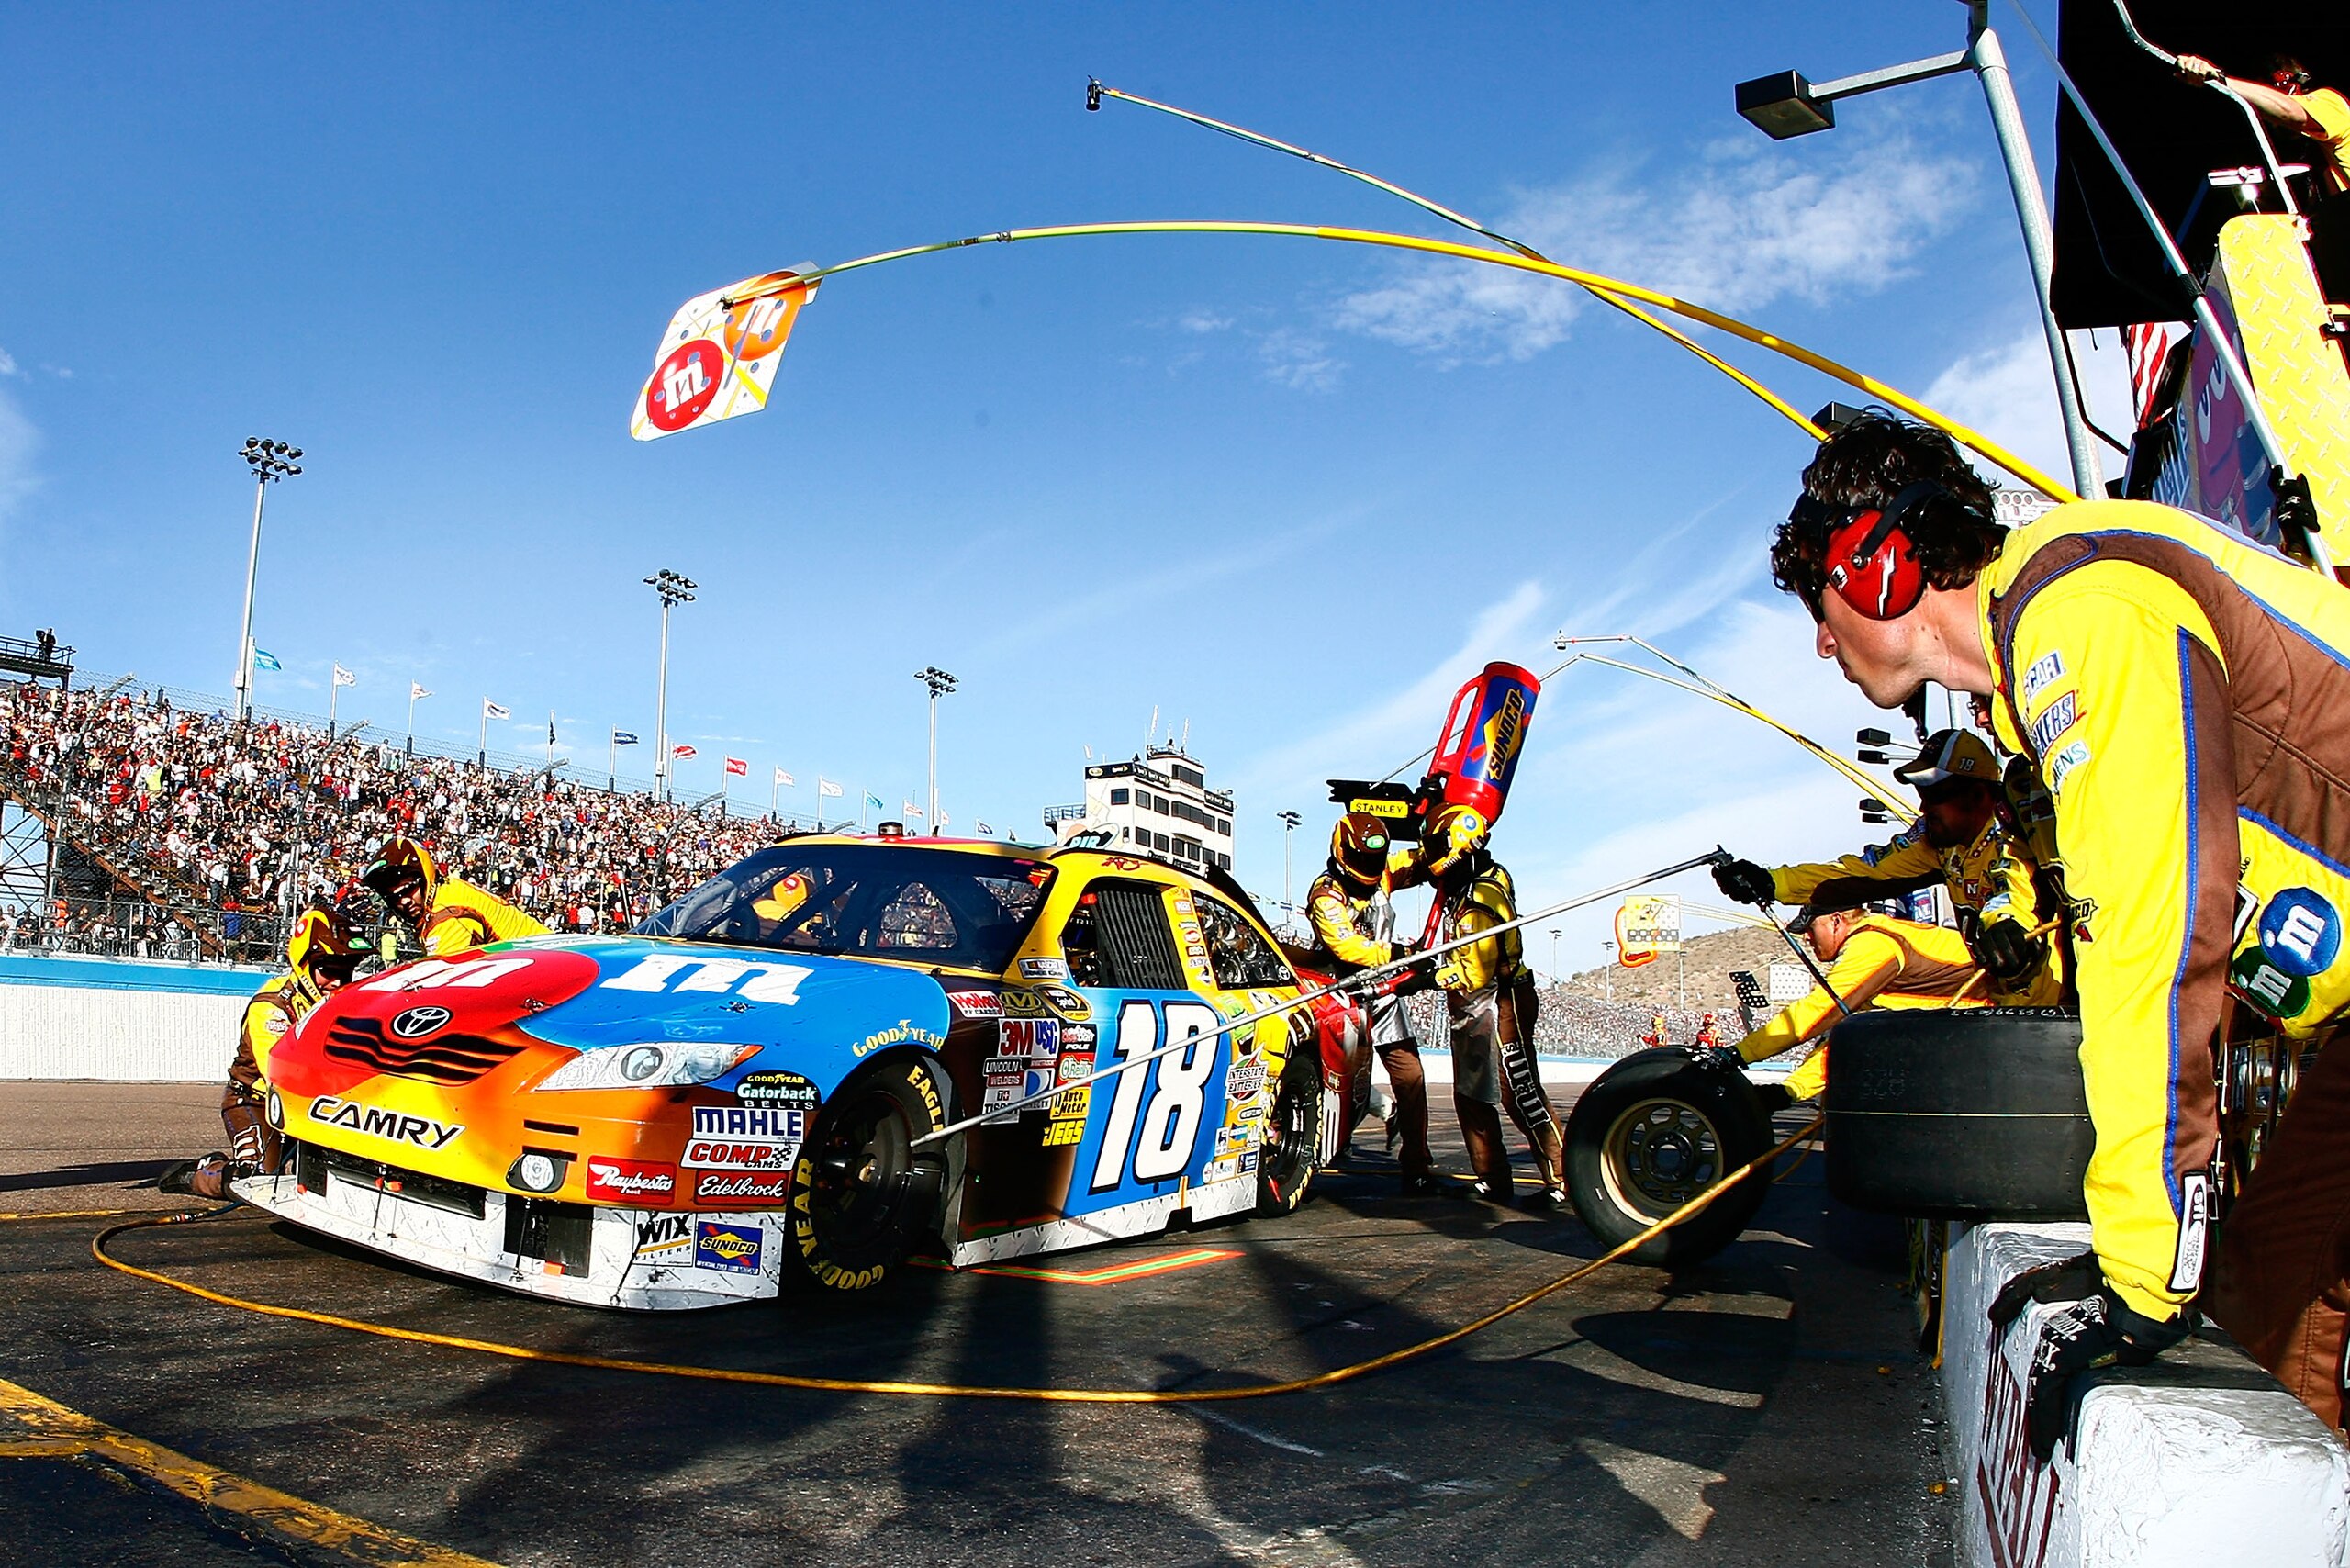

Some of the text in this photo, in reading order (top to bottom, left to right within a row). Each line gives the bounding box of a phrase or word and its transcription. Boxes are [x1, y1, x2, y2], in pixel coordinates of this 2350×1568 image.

[1488, 689, 1525, 779] SUNOCO
[1958, 758, 1975, 772] 18
[1355, 802, 1404, 814] STANLEY
[1069, 835, 1101, 848] PIR
[2277, 904, 2326, 962] m
[599, 953, 815, 1006] m
[2249, 964, 2293, 1007] m
[951, 993, 1003, 1014] Holley
[852, 1019, 945, 1058] GOODYEAR
[1001, 1021, 1034, 1056] 3M
[1035, 1020, 1058, 1054] USG
[986, 1061, 1019, 1073] LINCOLN
[1229, 1066, 1266, 1080] INTERSTATE
[747, 1074, 805, 1084] GOODYEAR
[990, 1075, 1020, 1085] WELDERS
[1228, 1079, 1262, 1093] BATTERIES
[737, 1083, 816, 1100] Gatorback
[1063, 1090, 1083, 1102] Auto
[1090, 1000, 1221, 1193] 18
[744, 1100, 814, 1110] BELTS
[1061, 1103, 1086, 1114] Meter
[309, 1096, 464, 1149] CAMRY
[695, 1108, 802, 1137] MAHLE
[1043, 1120, 1086, 1146] JEGS
[689, 1143, 772, 1163] COMP
[698, 1176, 783, 1197] Edelbrock
[637, 1215, 690, 1245] WIX
[633, 1245, 691, 1261] FILTERS
[701, 1238, 756, 1254] SUNOCO
